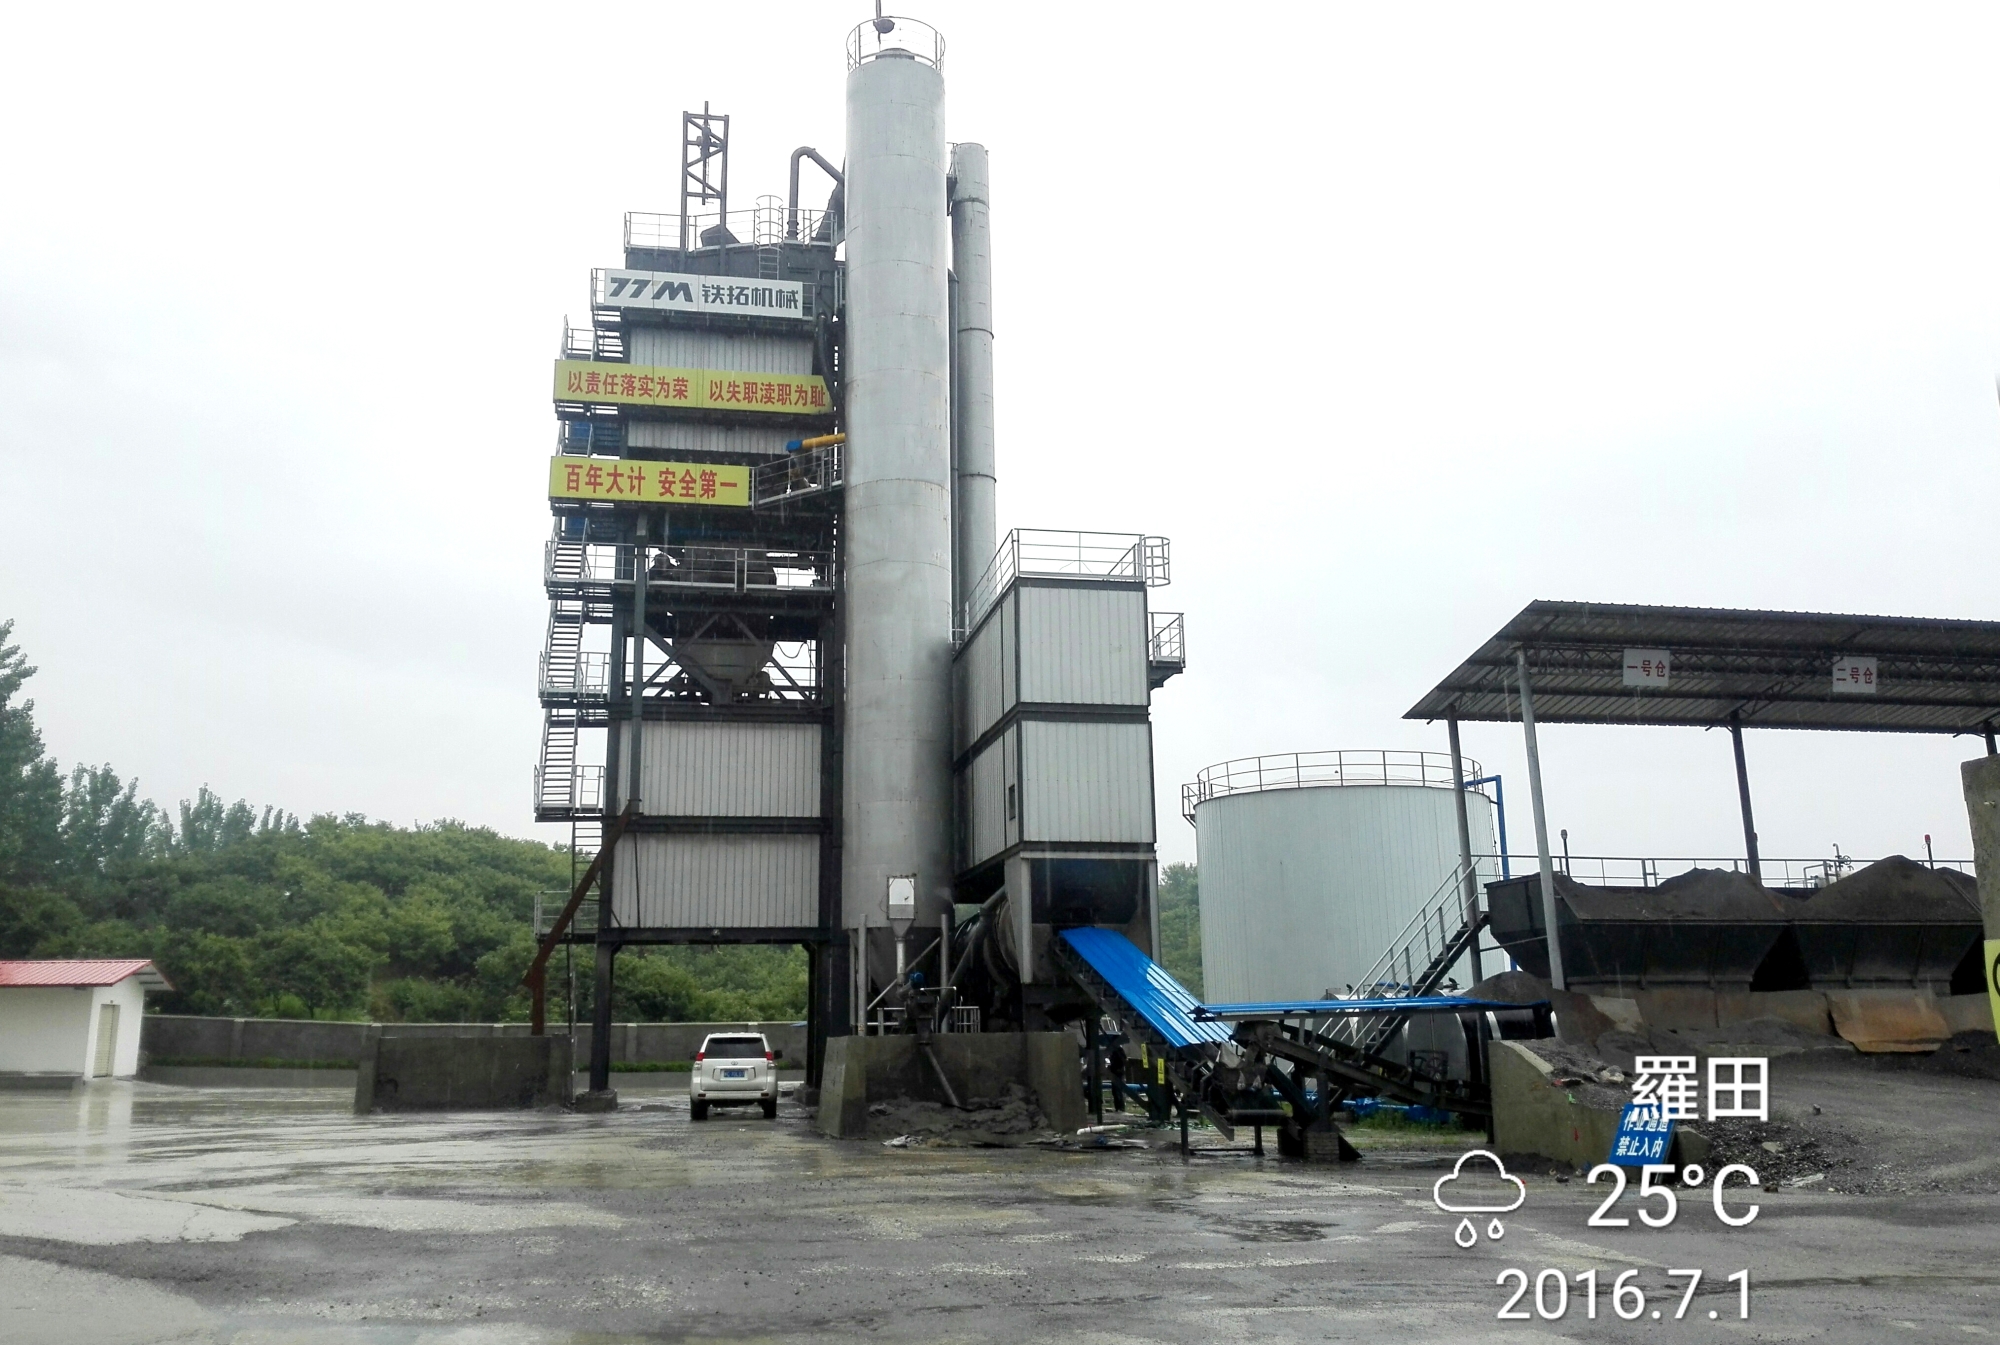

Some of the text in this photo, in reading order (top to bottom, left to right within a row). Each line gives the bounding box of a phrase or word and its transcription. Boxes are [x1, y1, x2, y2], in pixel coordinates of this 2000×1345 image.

[702, 283, 799, 310] 铁拓机械
[567, 370, 826, 408] 以责任落实为荣 以失职渎职为耻
[564, 463, 738, 499] 百年大计 安全第一
[1627, 659, 1666, 678] 一号仓
[1836, 666, 1874, 685] 二号仓
[1616, 1135, 1664, 1158] 禁止入内
